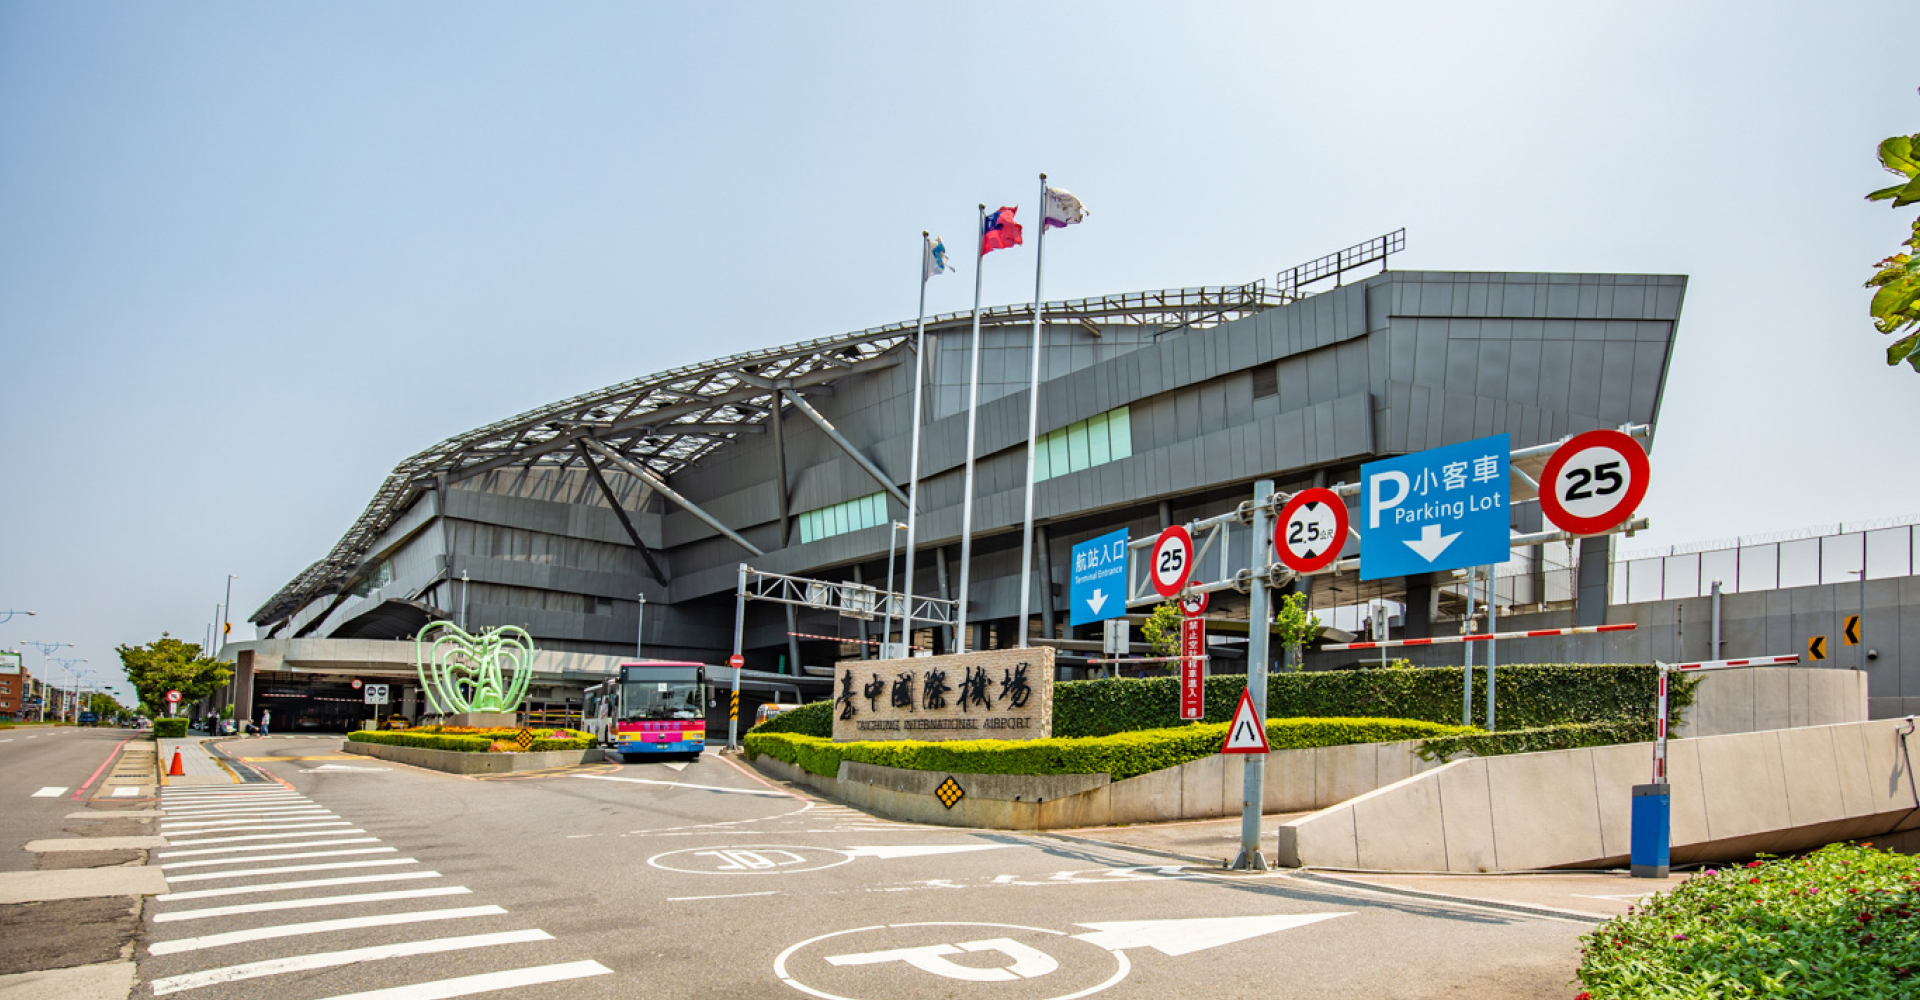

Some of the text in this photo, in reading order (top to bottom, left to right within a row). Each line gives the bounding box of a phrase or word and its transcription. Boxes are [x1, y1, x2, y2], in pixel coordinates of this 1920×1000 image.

[1413, 454, 1500, 496] 小客車
[1565, 461, 1623, 501] 25
[1369, 469, 1410, 528] P
[1395, 492, 1501, 524] Parking Lot
[1075, 539, 1124, 573] 航站入口
[1160, 548, 1183, 573] 25
[1075, 566, 1123, 585] Terminal Entrance
[835, 662, 1033, 721] 臺中國際機場
[856, 716, 1032, 732] TAICHUNG INTERNATIONAL AIRPORT
